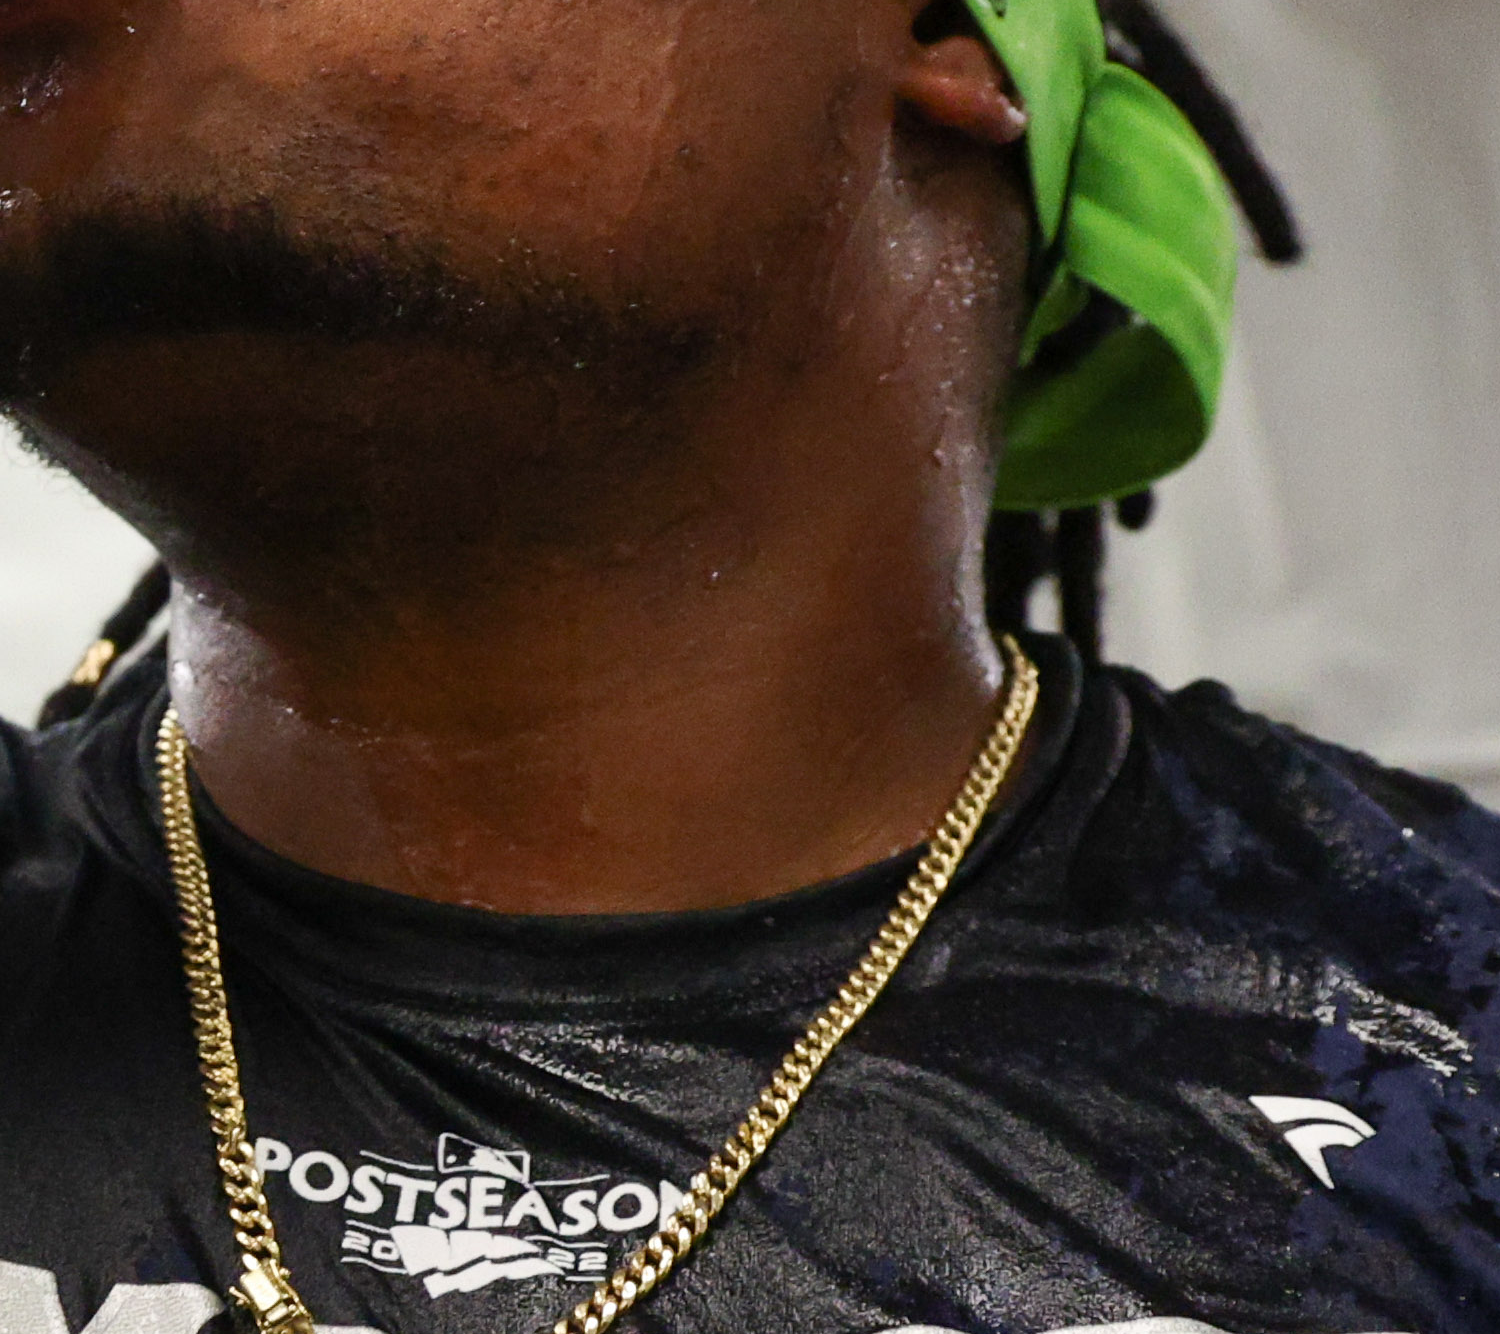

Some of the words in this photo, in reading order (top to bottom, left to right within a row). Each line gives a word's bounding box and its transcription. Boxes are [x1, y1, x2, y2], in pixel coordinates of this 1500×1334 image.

[255, 1133, 690, 1237] POSTSEASON
[341, 1229, 400, 1262] 20
[546, 1245, 608, 1272] 22
